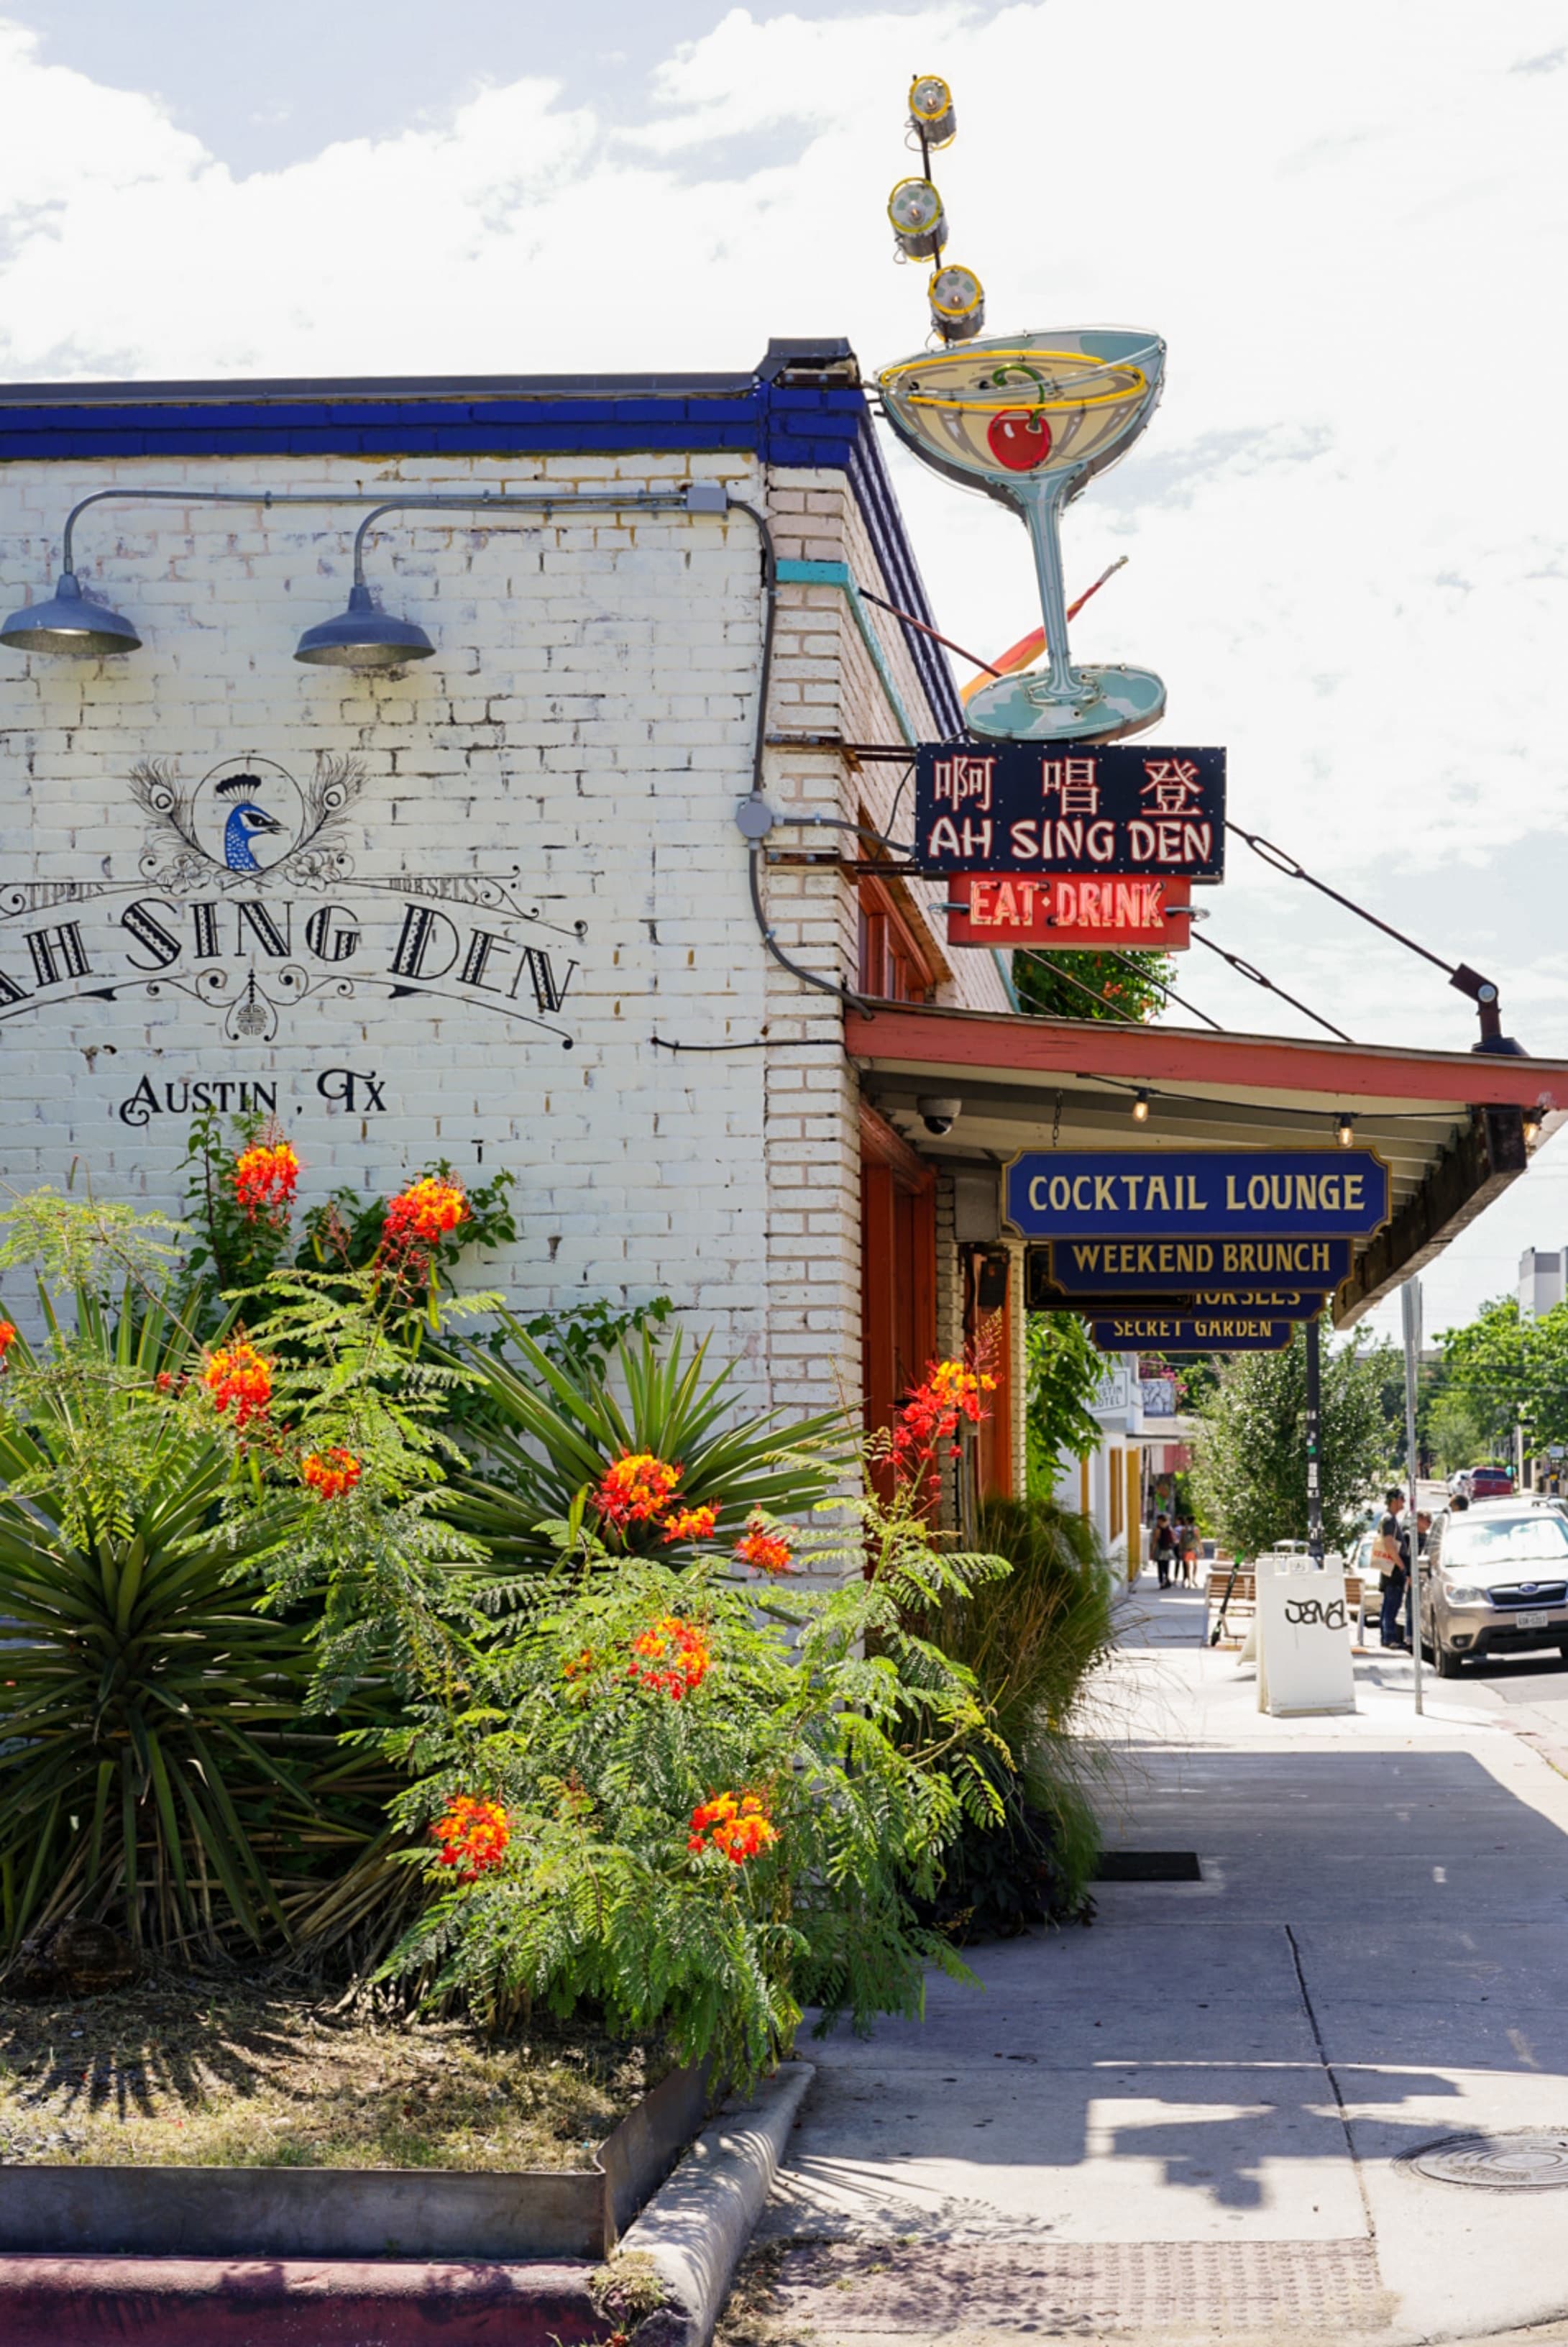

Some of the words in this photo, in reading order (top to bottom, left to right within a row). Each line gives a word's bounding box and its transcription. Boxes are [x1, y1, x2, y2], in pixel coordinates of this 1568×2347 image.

[928, 818, 992, 859] AH
[1009, 820, 1116, 861] SING
[1127, 821, 1211, 862] DEN
[970, 880, 1040, 927] EAT
[1057, 882, 1164, 928] DRINK
[121, 897, 361, 971] SING
[388, 902, 580, 1013] DEN
[317, 1069, 387, 1112] TX
[1028, 1175, 1208, 1211] COCKTAIL
[1226, 1174, 1365, 1210] LOUNGE
[1073, 1244, 1213, 1273] WEEKEND
[1223, 1243, 1330, 1272] BRUNCH
[1114, 1320, 1180, 1337] SECRET
[1195, 1320, 1272, 1337] GARDEN
